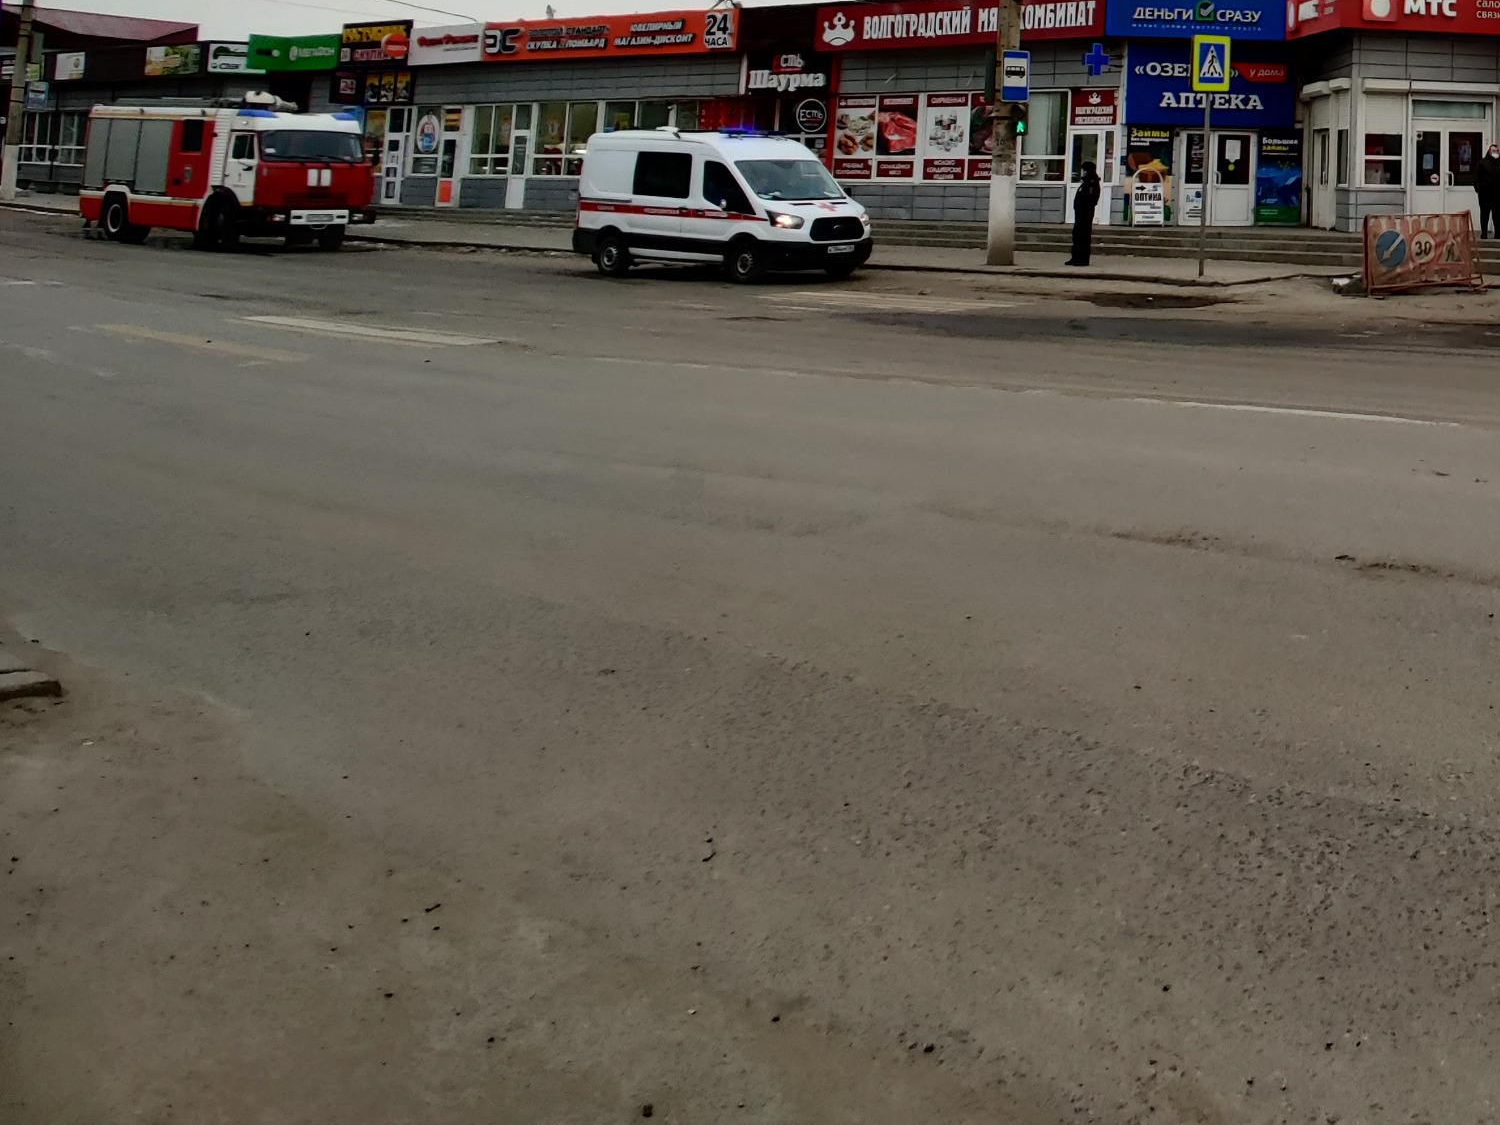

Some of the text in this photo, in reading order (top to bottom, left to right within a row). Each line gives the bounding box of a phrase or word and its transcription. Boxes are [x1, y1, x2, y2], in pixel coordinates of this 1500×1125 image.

[863, 1, 1096, 39] ВОЛГОГРАДСКИЙ МЯКОМБИНАТ
[1133, 7, 1261, 22] ДЕНЬГИ СРАЗУ
[630, 20, 683, 32] ЮВЕЛИРНЫЙ
[706, 14, 729, 35] 24
[704, 36, 728, 46] ЧАСА
[1257, 68, 1285, 78] дома
[341, 79, 355, 92] 24
[748, 70, 826, 92] Шаурма
[1159, 92, 1264, 110] АПТЕКА
[1262, 137, 1298, 145] Большие
[1135, 192, 1162, 202] ОПТИКА
[1415, 240, 1432, 257] 30
